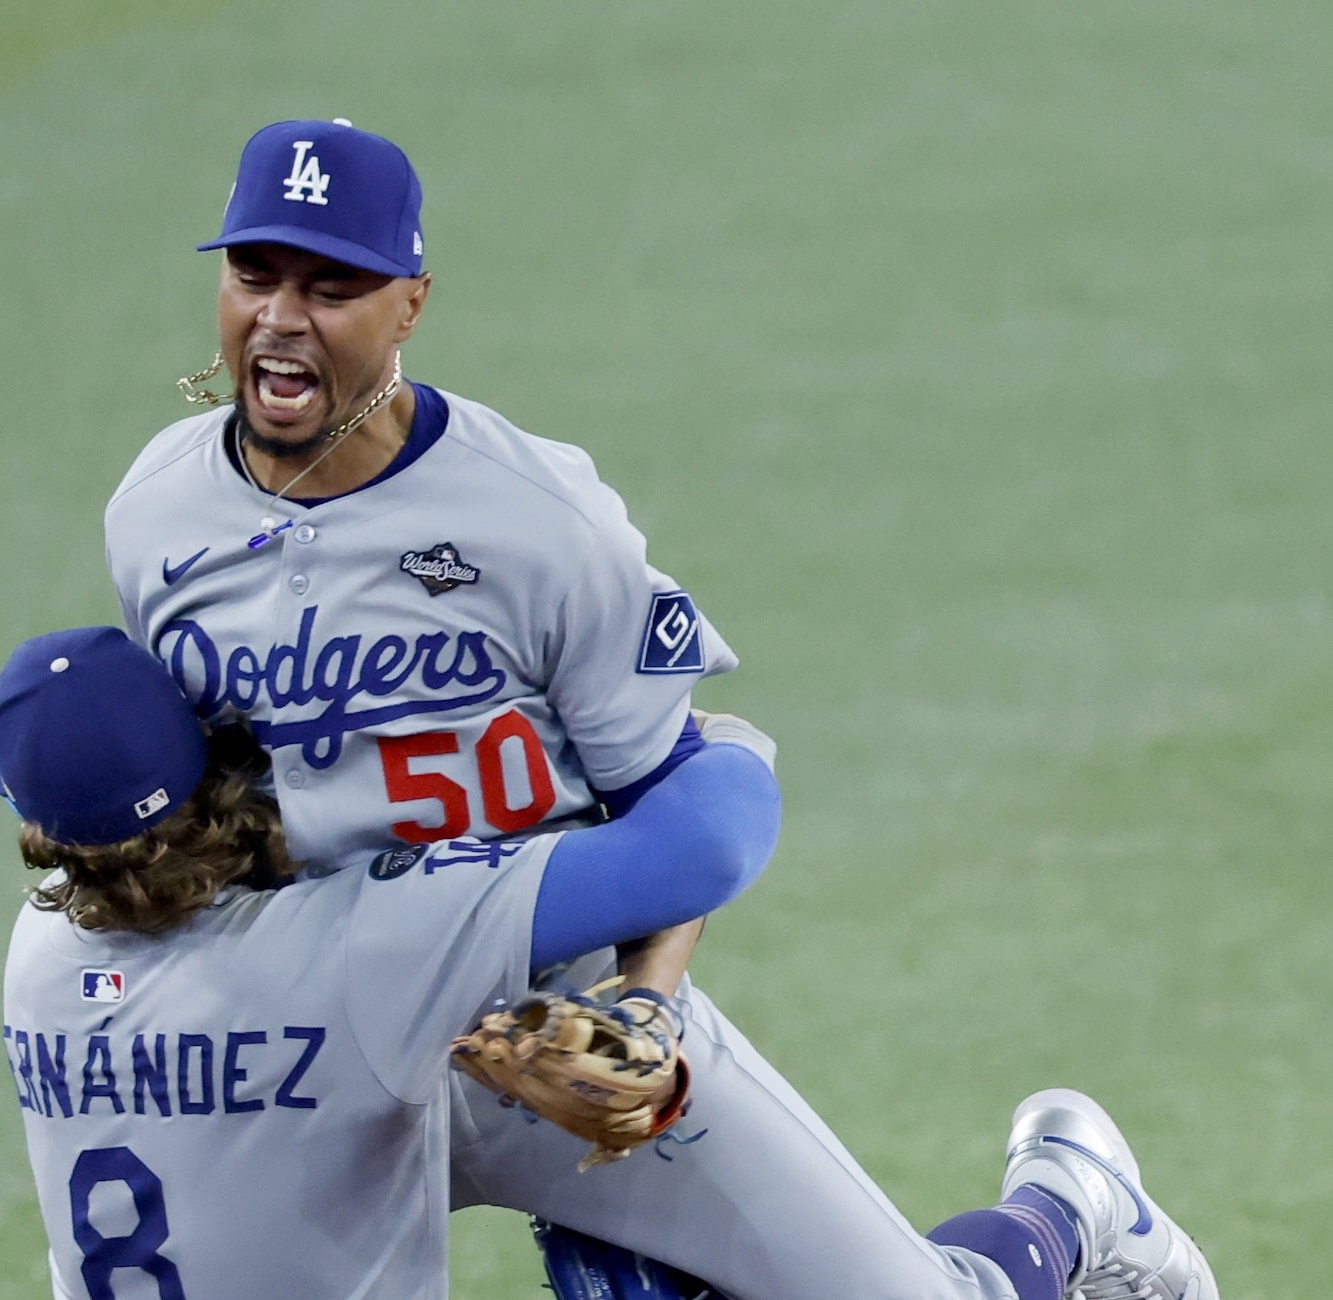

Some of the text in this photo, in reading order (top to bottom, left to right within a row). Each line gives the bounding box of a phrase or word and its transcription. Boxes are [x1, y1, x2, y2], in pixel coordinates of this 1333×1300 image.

[283, 141, 331, 206] LA
[402, 553, 476, 581] World Series
[157, 605, 507, 770] Dodgers
[378, 708, 557, 844] 50
